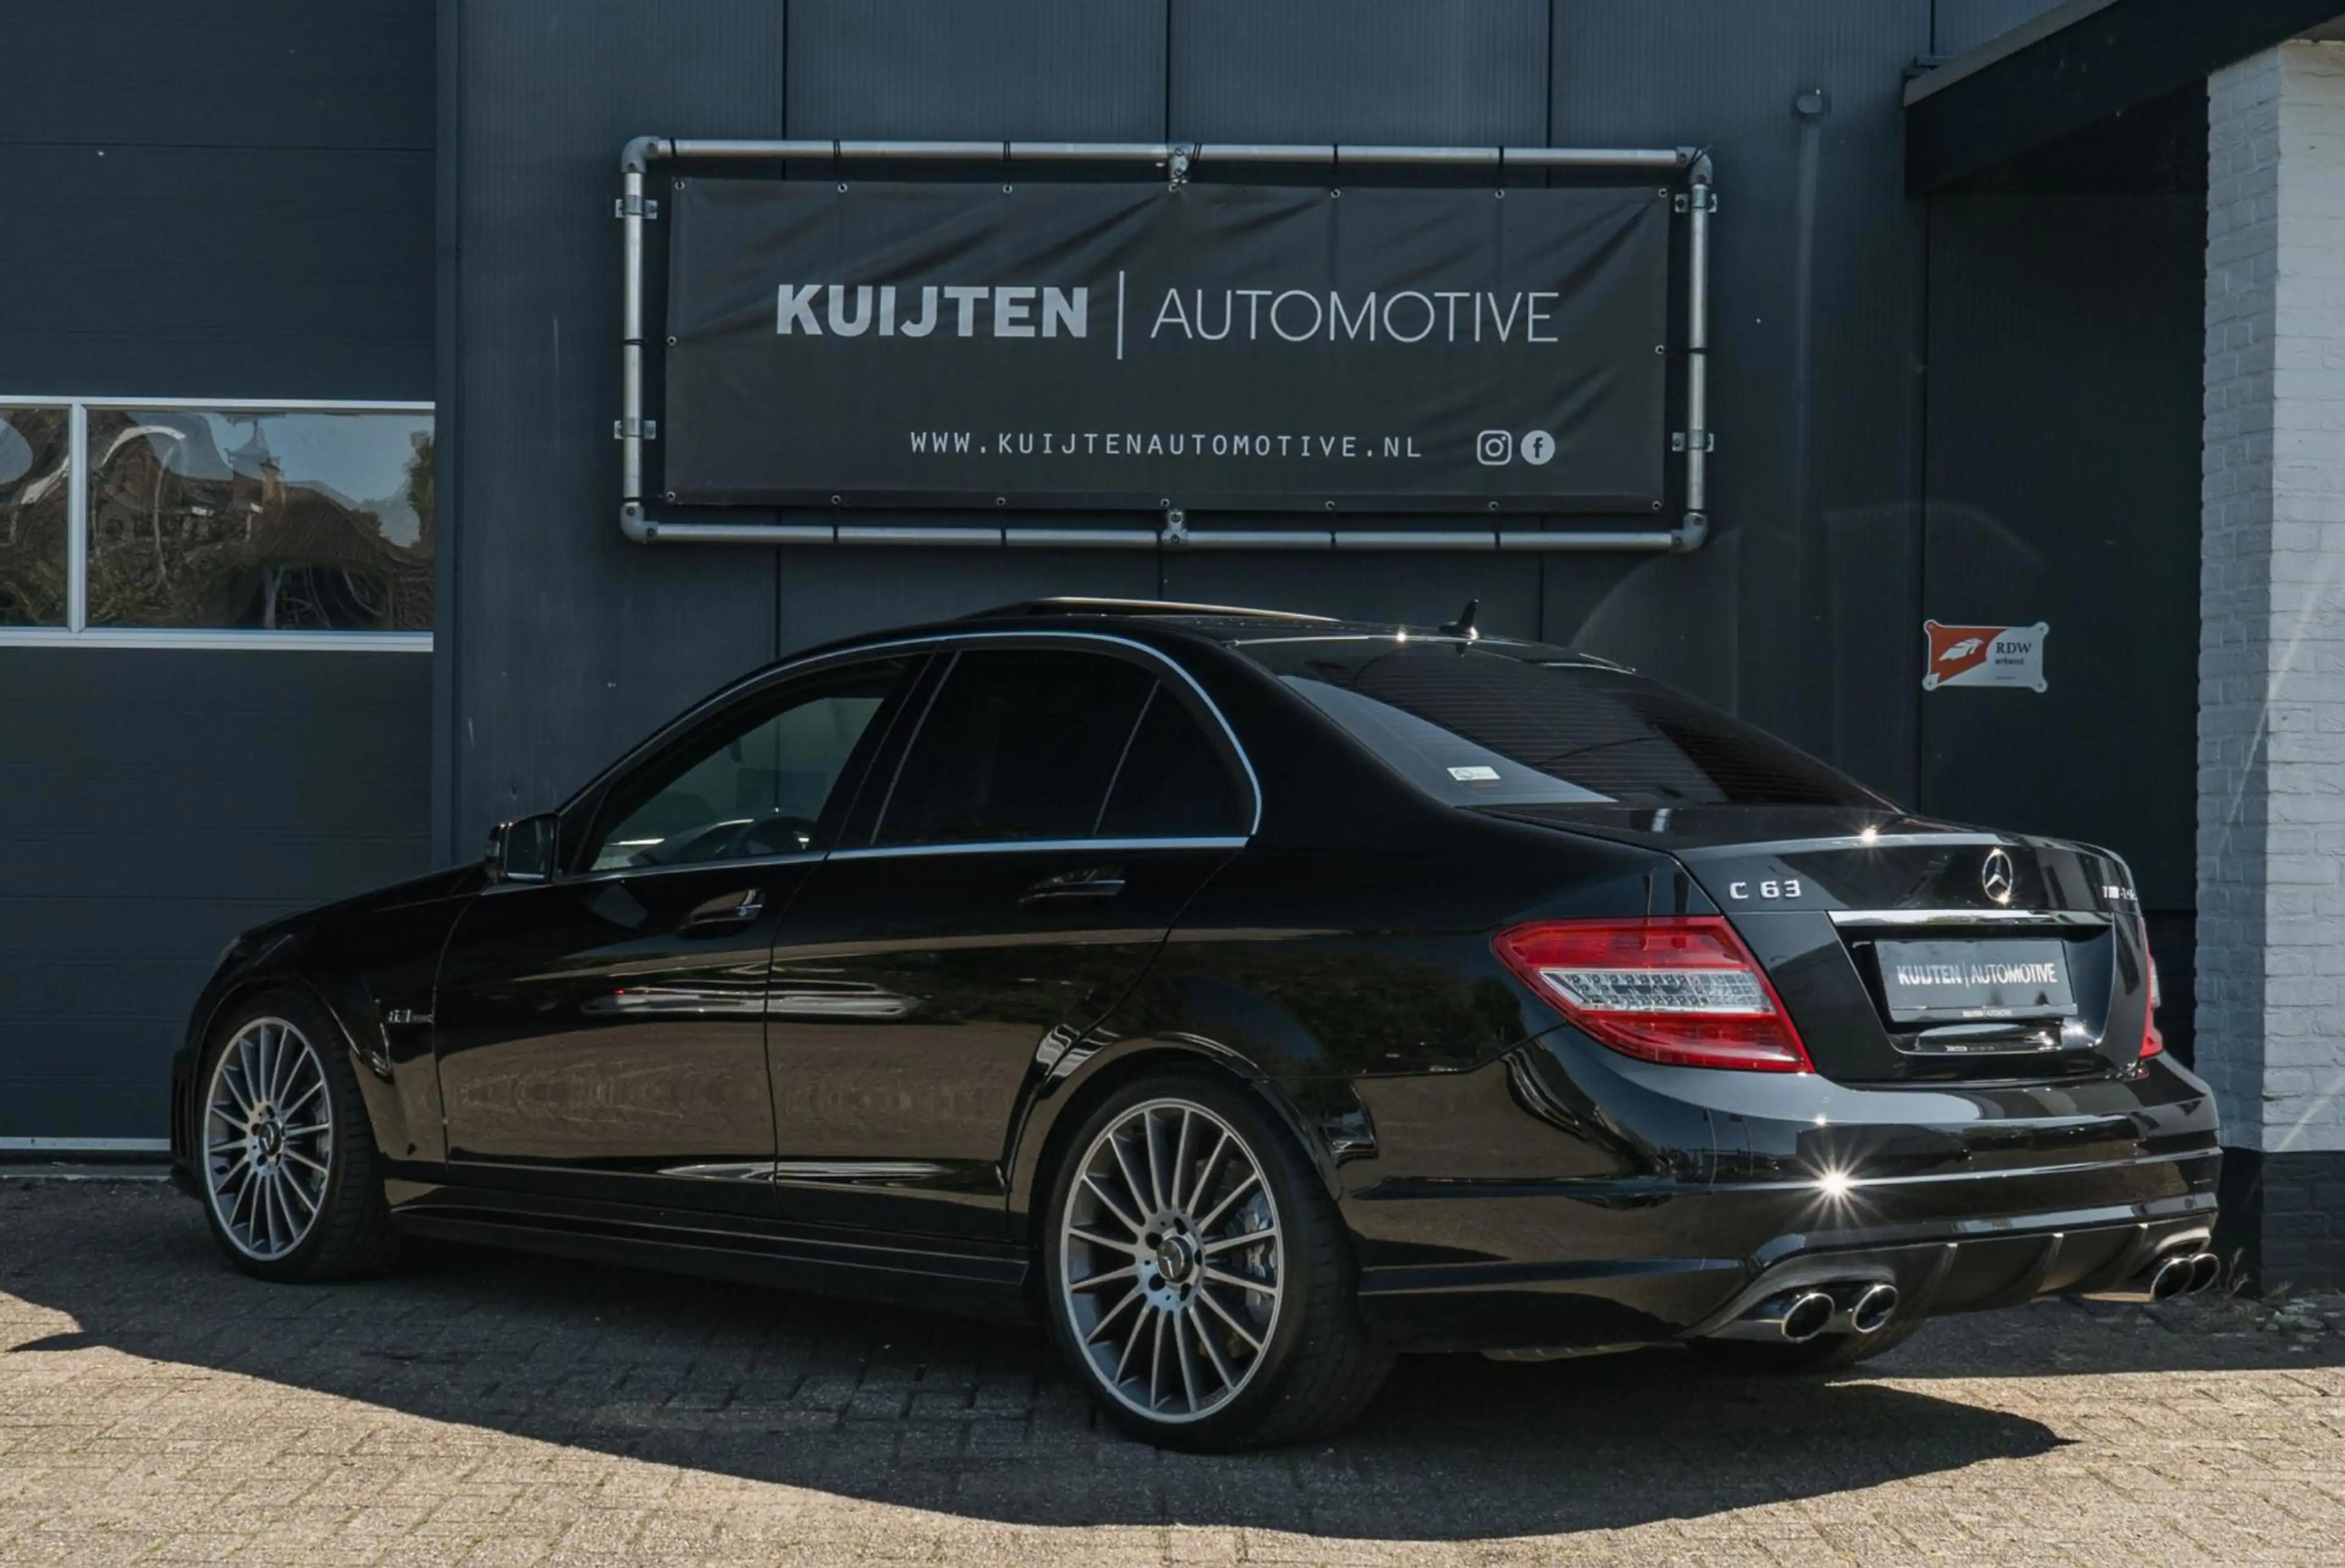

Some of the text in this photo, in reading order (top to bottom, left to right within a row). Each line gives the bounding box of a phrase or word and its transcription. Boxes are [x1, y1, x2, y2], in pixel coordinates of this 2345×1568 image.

[776, 284, 1560, 343] KUIJTEN AUTOMOTIVE
[910, 431, 1422, 459] WWW.KUIJTENAUTOMOTIVE.NL
[1996, 642, 2032, 654] RDW
[1729, 879, 1802, 899] C 63
[1896, 963, 2058, 985] KUIJTEN AUTOMOTIVE
